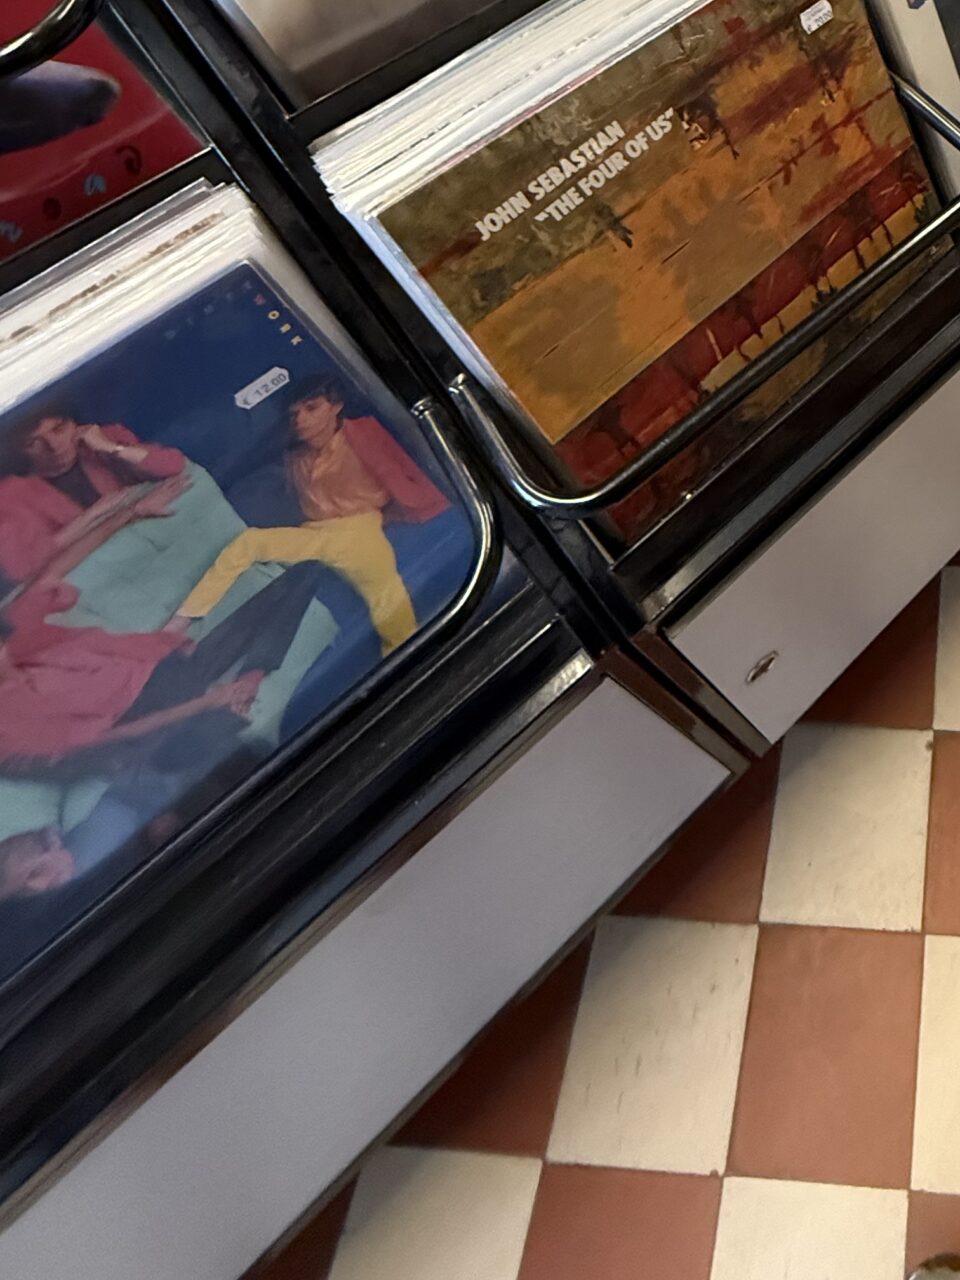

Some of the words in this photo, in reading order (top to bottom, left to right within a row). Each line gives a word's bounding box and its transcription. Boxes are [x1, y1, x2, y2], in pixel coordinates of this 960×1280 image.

[474, 194, 531, 242] JOHN
[529, 119, 626, 202] SEBASTIAN
[579, 153, 631, 198] FOUR
[625, 136, 652, 164] OF
